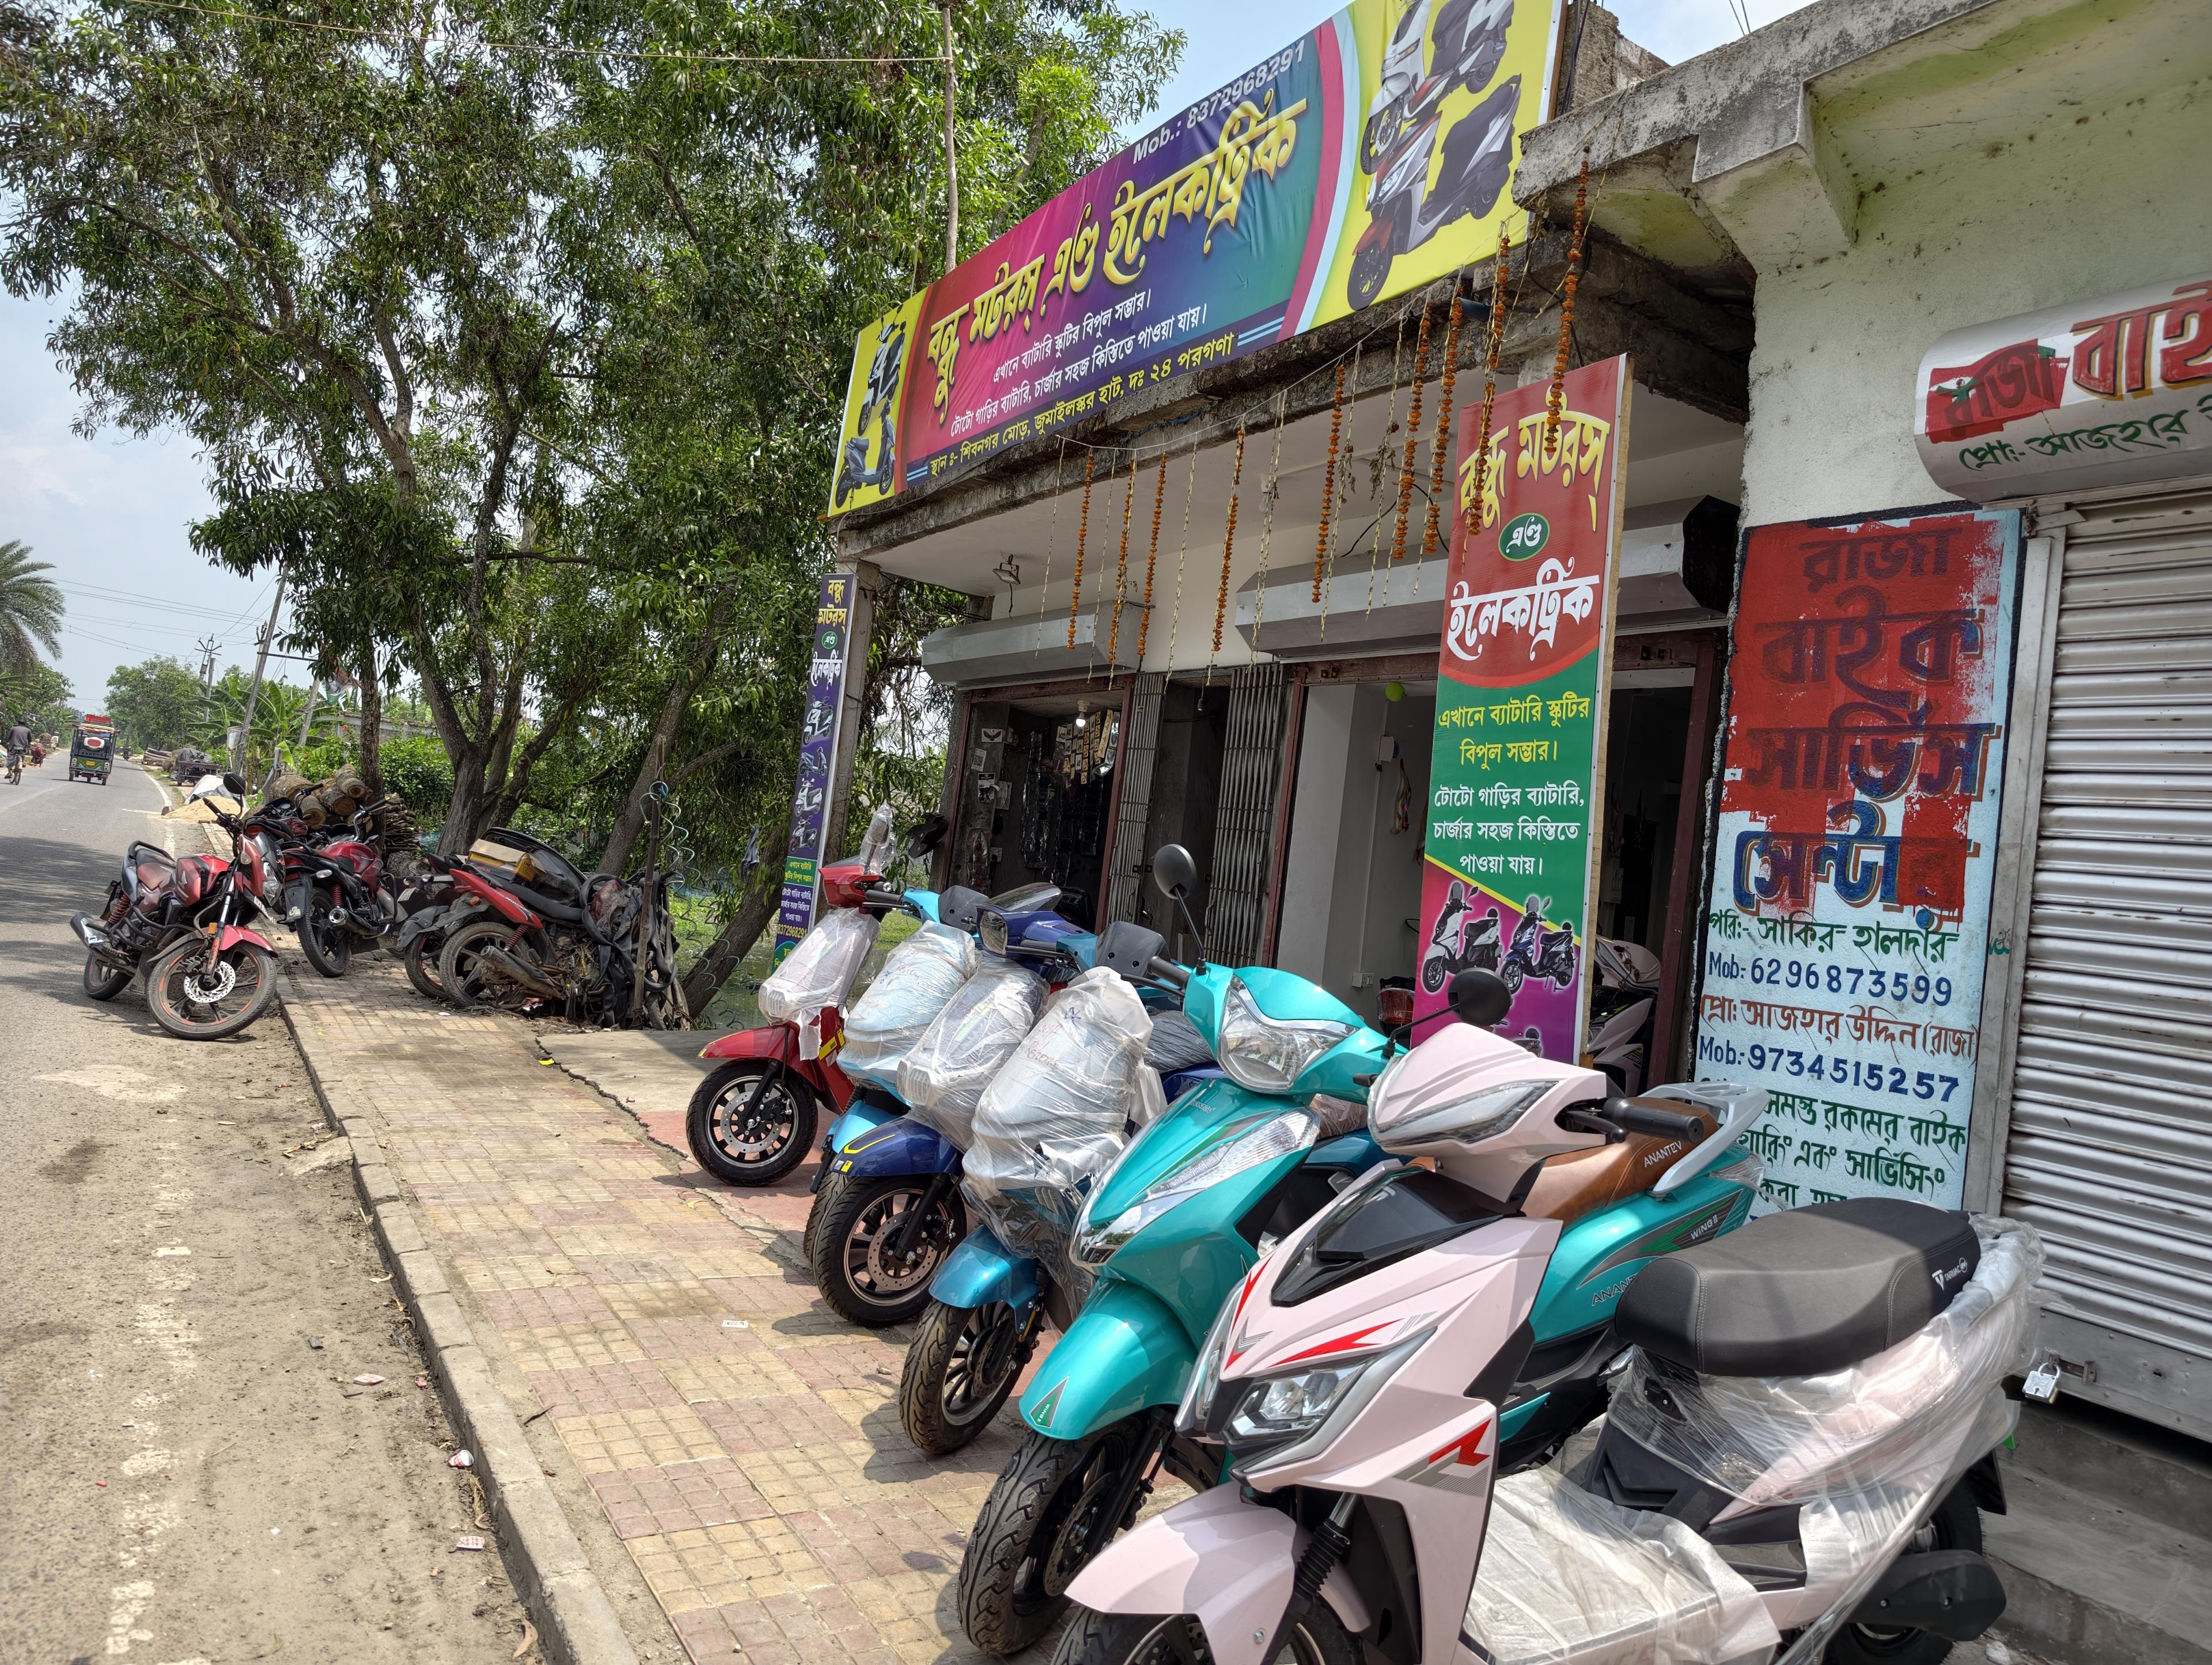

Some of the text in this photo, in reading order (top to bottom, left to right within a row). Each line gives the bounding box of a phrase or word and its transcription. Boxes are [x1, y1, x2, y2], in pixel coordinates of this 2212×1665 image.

[1187, 39, 1305, 129] 8372968291
[927, 303, 969, 424] বন্ধু
[994, 355, 1018, 383] এখানে
[1021, 334, 1052, 368] ব্যাটারি
[1054, 323, 1080, 358] স্কুটির
[1082, 308, 1112, 339] বিপুল
[2070, 280, 2212, 401] বাই
[930, 454, 948, 477] স্থান
[960, 433, 999, 463] শিবনগর
[1150, 358, 1171, 382] ২৪
[1177, 331, 1234, 370] পরগণা
[950, 409, 973, 437] টোটো
[975, 399, 998, 425] গাড়ির
[1035, 365, 1063, 398] চার্জার
[1065, 356, 1090, 383] সহজ
[1092, 335, 1135, 373] কিস্তিতে
[1138, 315, 1175, 349] পাওয়া
[1753, 585, 1985, 711] বাইক
[1438, 691, 1590, 729] এখানে ব্যাটারি স্কুটির
[1459, 738, 1502, 771] বিপুল
[1434, 780, 1584, 809] টোটো গাড়ির ব্যাটারি,
[1433, 816, 1581, 842] চার্জার সহজ কিস্তিতে
[1460, 854, 1504, 875] পাওয়া
[1751, 958, 1952, 1007] 6296873599
[1748, 1044, 1959, 1102] 9734515257
[1794, 1140, 1837, 1173] এবং
[1908, 1109, 1967, 1171] বাইক
[1691, 1219, 1713, 1239] WING
